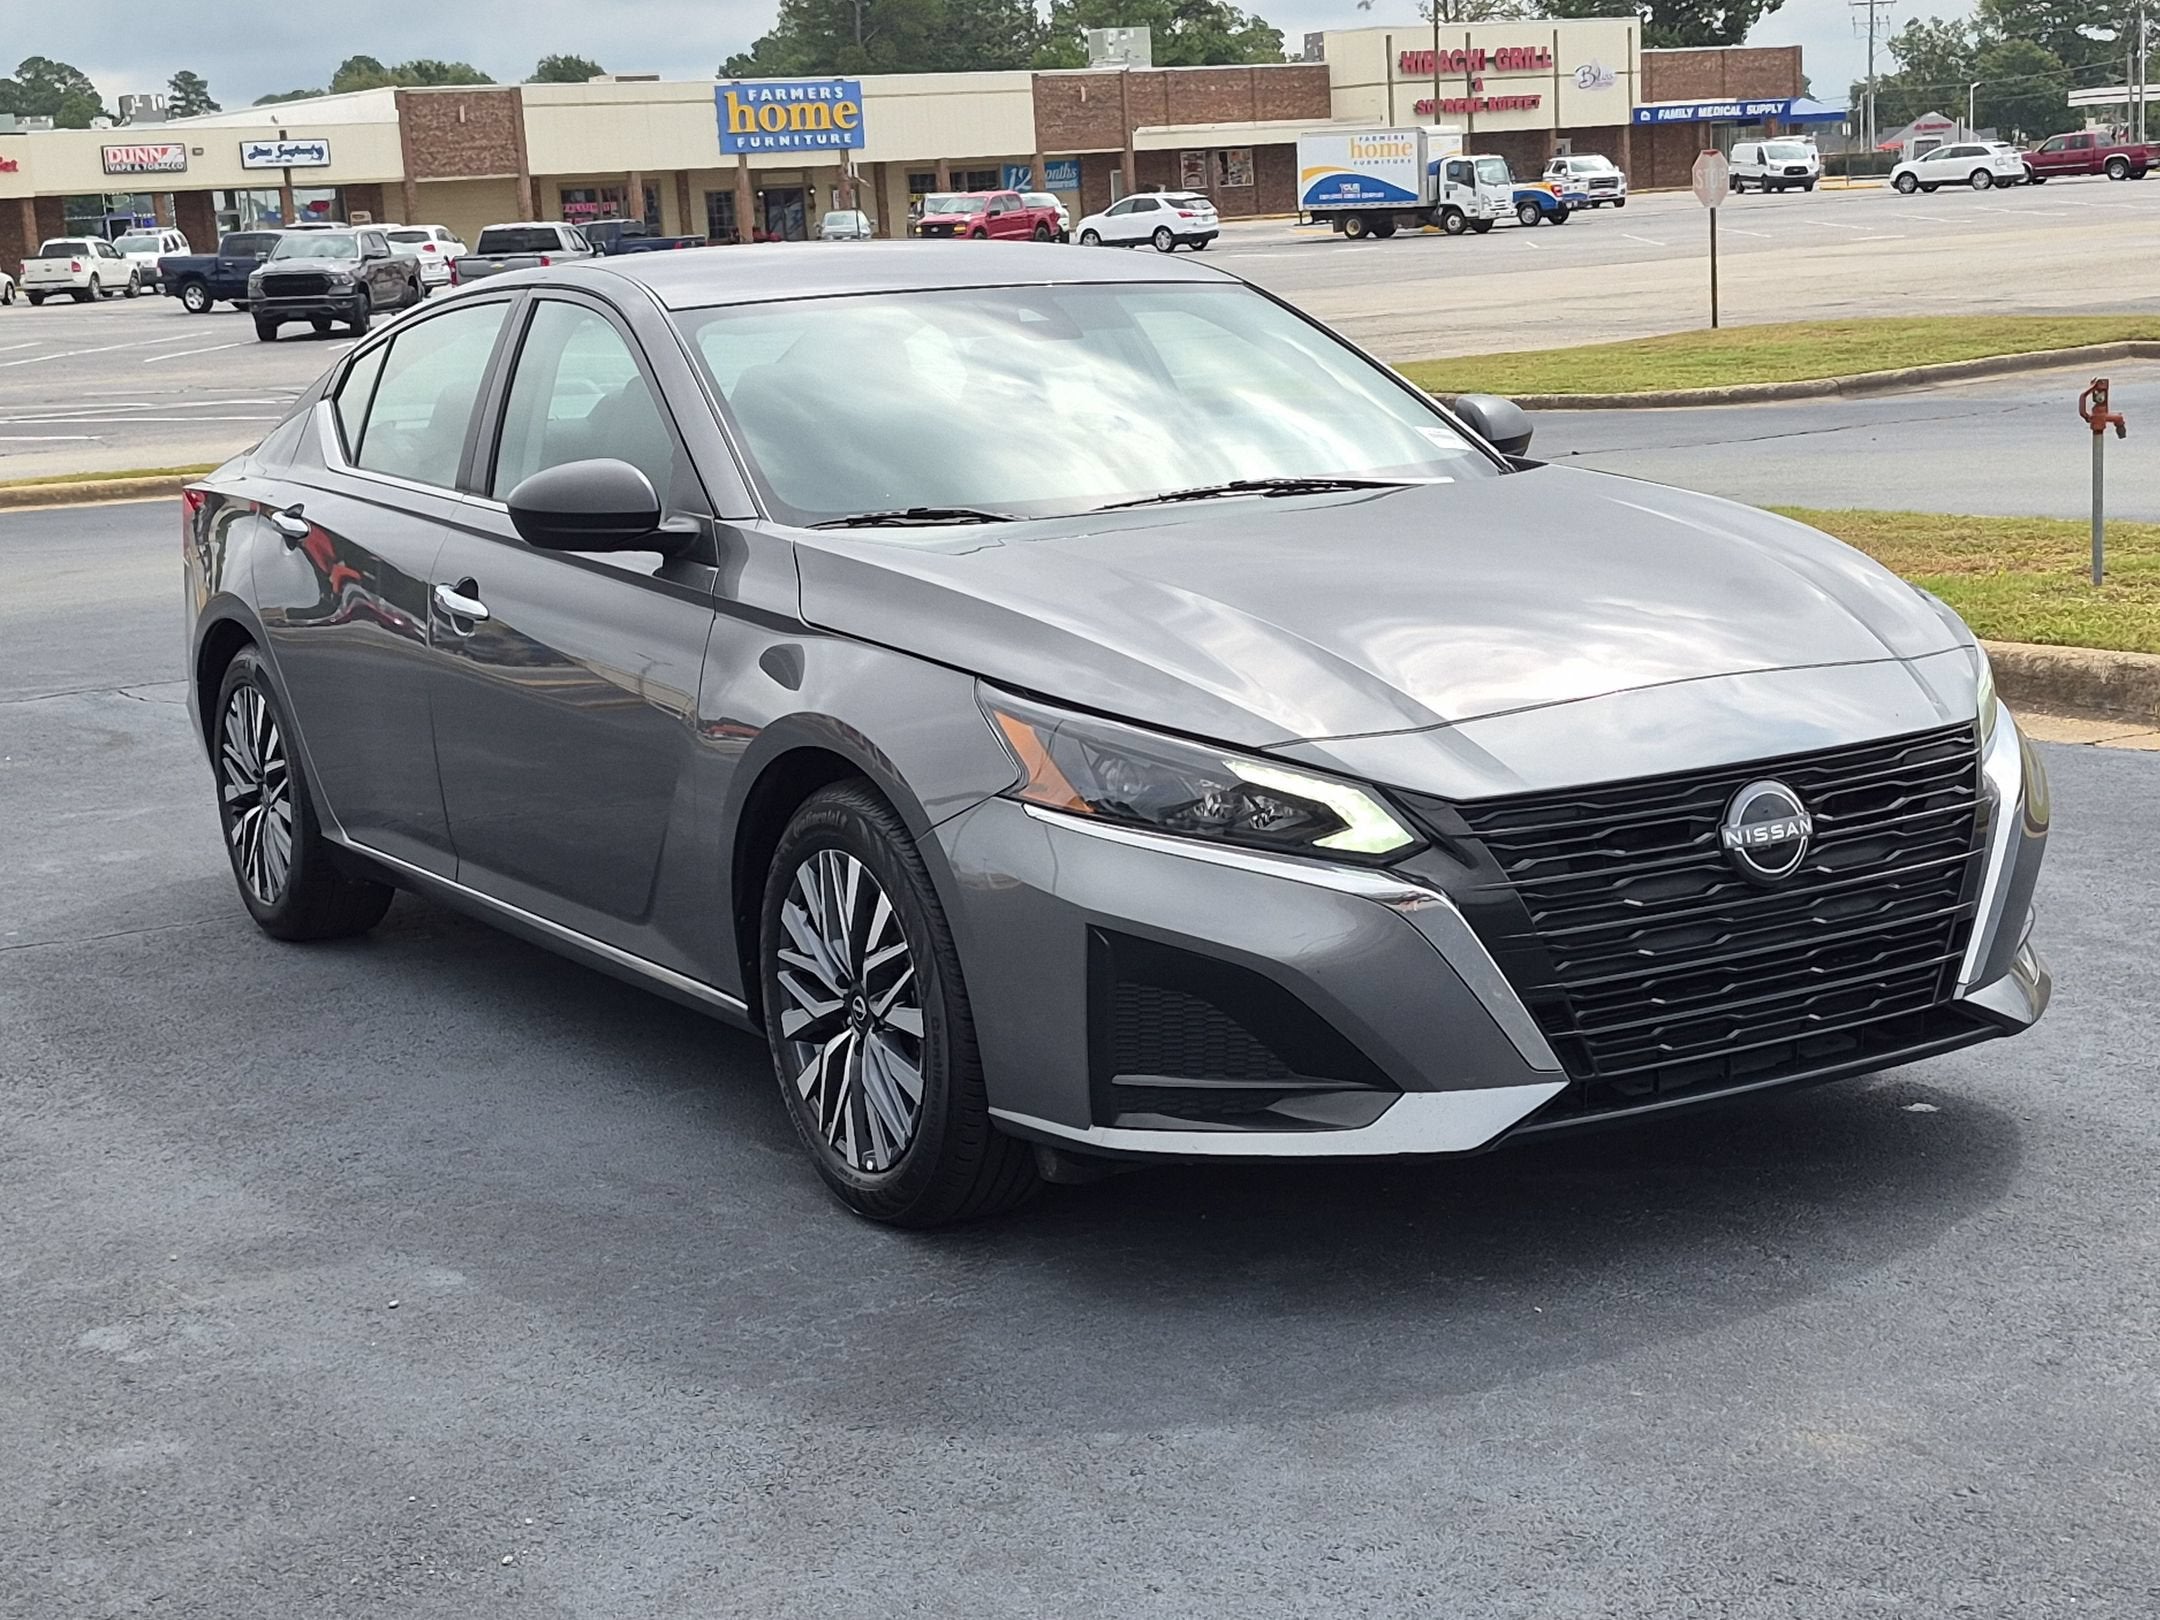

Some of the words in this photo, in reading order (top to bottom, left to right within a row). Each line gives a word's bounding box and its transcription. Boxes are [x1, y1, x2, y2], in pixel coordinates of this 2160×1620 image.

[1400, 49, 1486, 74] HIBACHI
[1495, 46, 1553, 71] GRILL
[748, 86, 844, 102] FARMERS
[725, 90, 858, 133] home
[1415, 97, 1484, 115] SUREME
[1658, 107, 1694, 120] FAMILY
[1698, 104, 1742, 118] MEDICAL
[1746, 103, 1785, 116] SUPPLY
[737, 133, 852, 148] FURNITURE
[1350, 137, 1413, 159] home
[107, 147, 161, 164] DUNN
[1695, 168, 1727, 190] STOP
[1725, 817, 1812, 846] NISSAN
